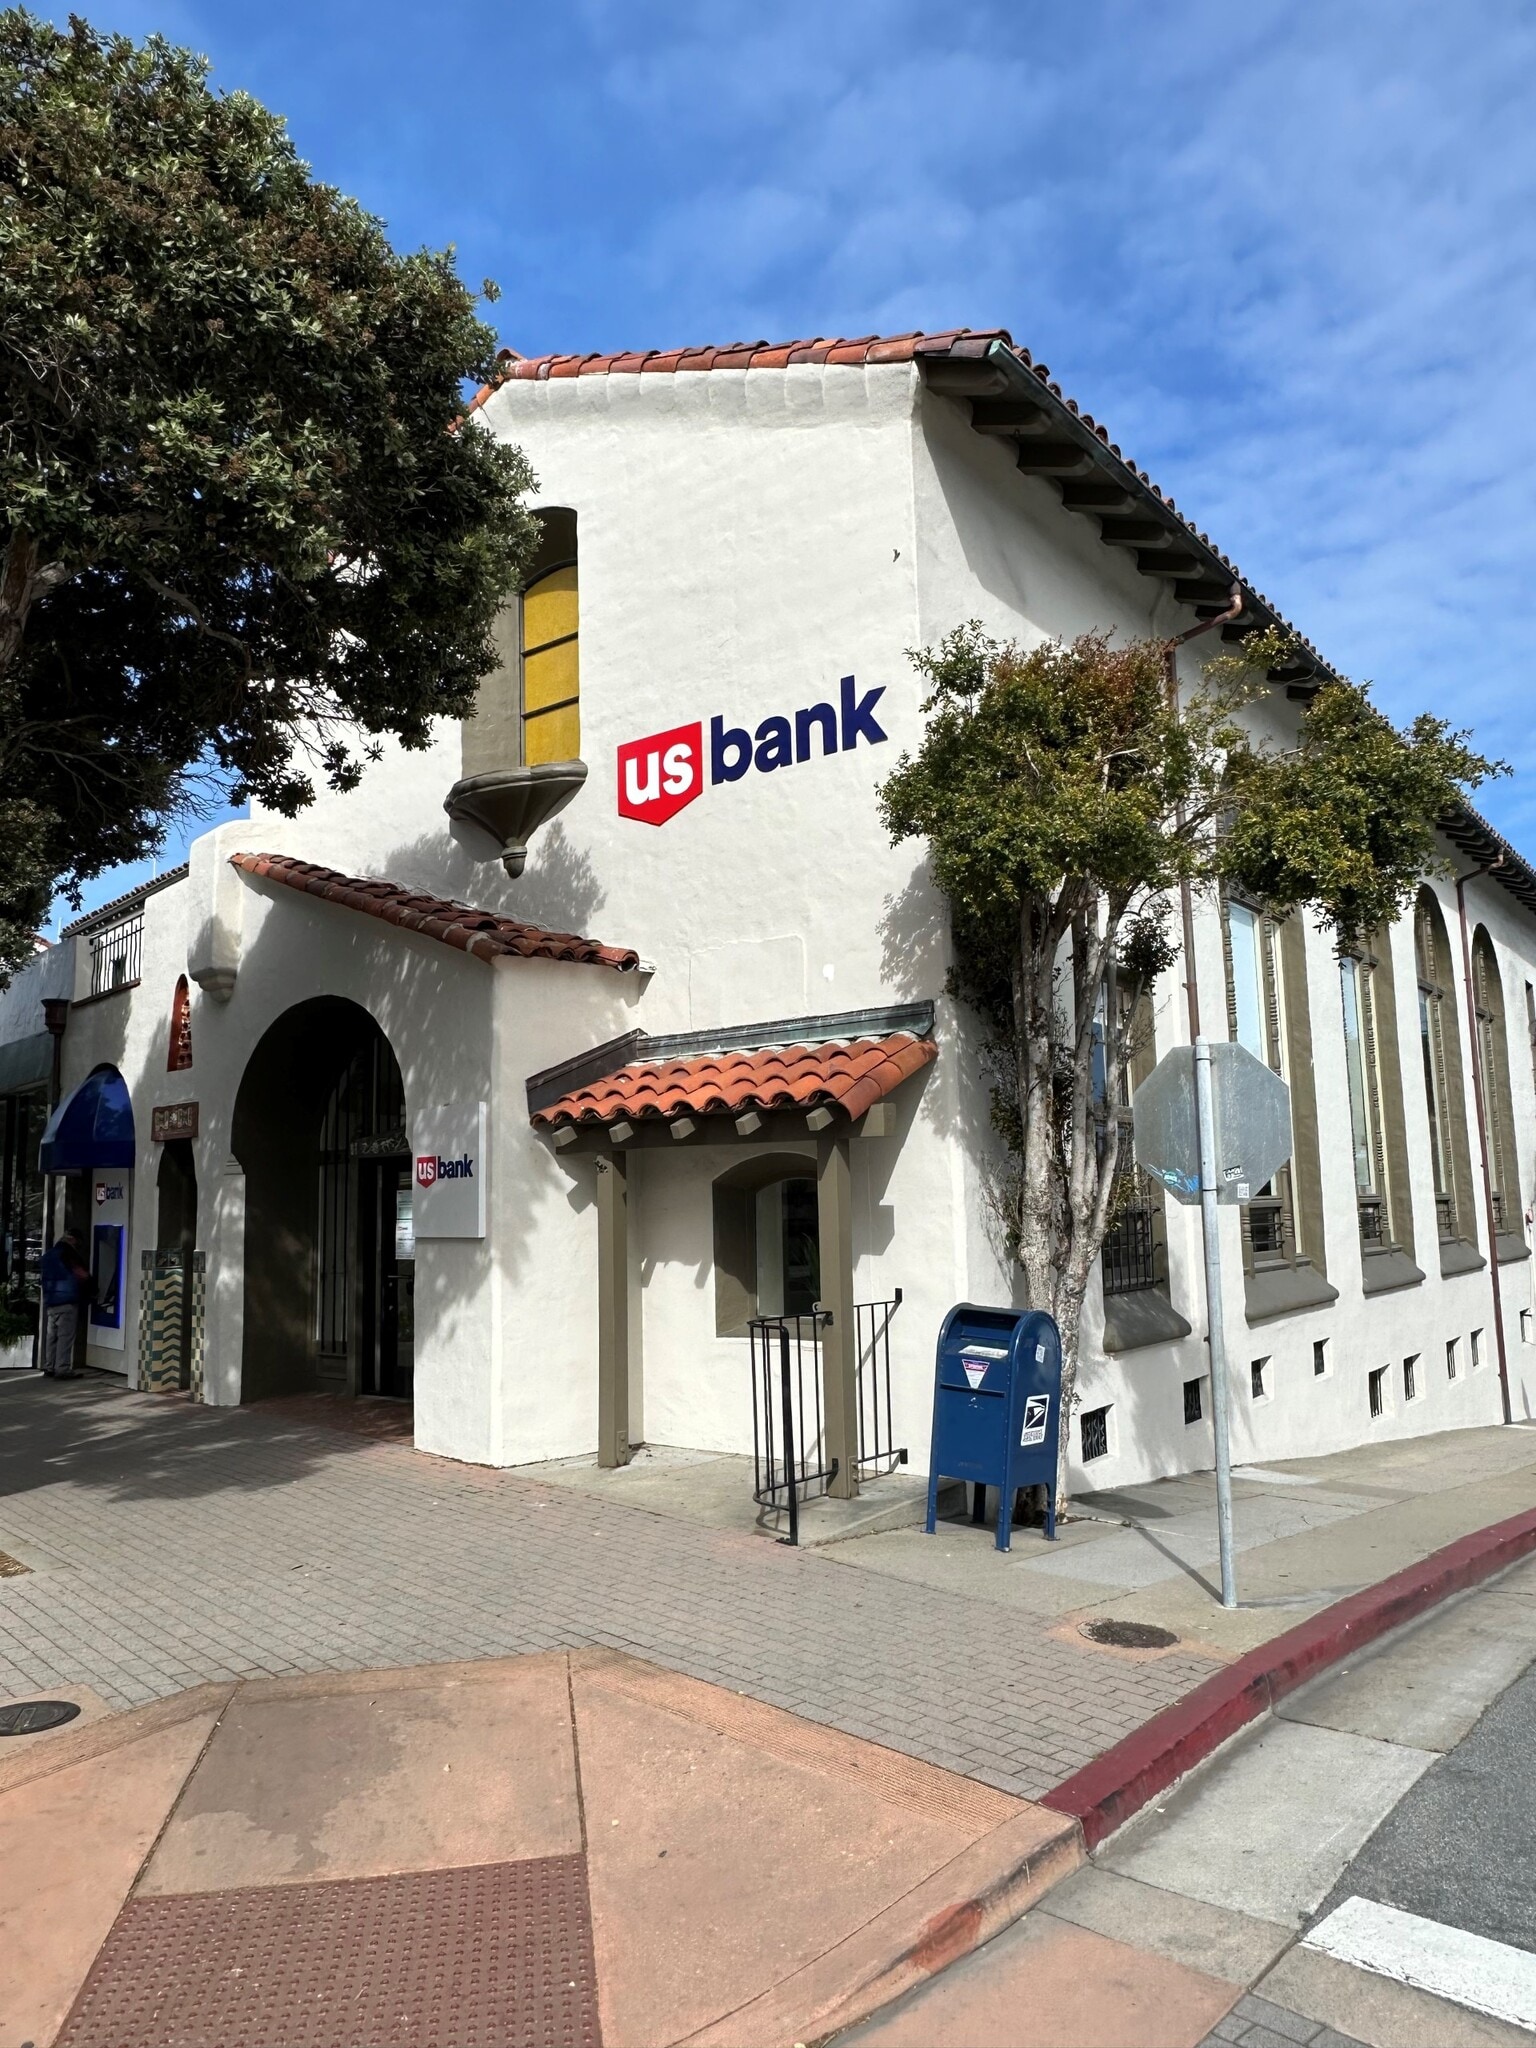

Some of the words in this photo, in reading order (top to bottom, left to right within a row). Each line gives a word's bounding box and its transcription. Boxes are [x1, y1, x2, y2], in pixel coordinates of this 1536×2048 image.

[625, 743, 694, 805] us
[711, 675, 888, 785] bank
[418, 1162, 435, 1180] us
[437, 1153, 473, 1179] bank
